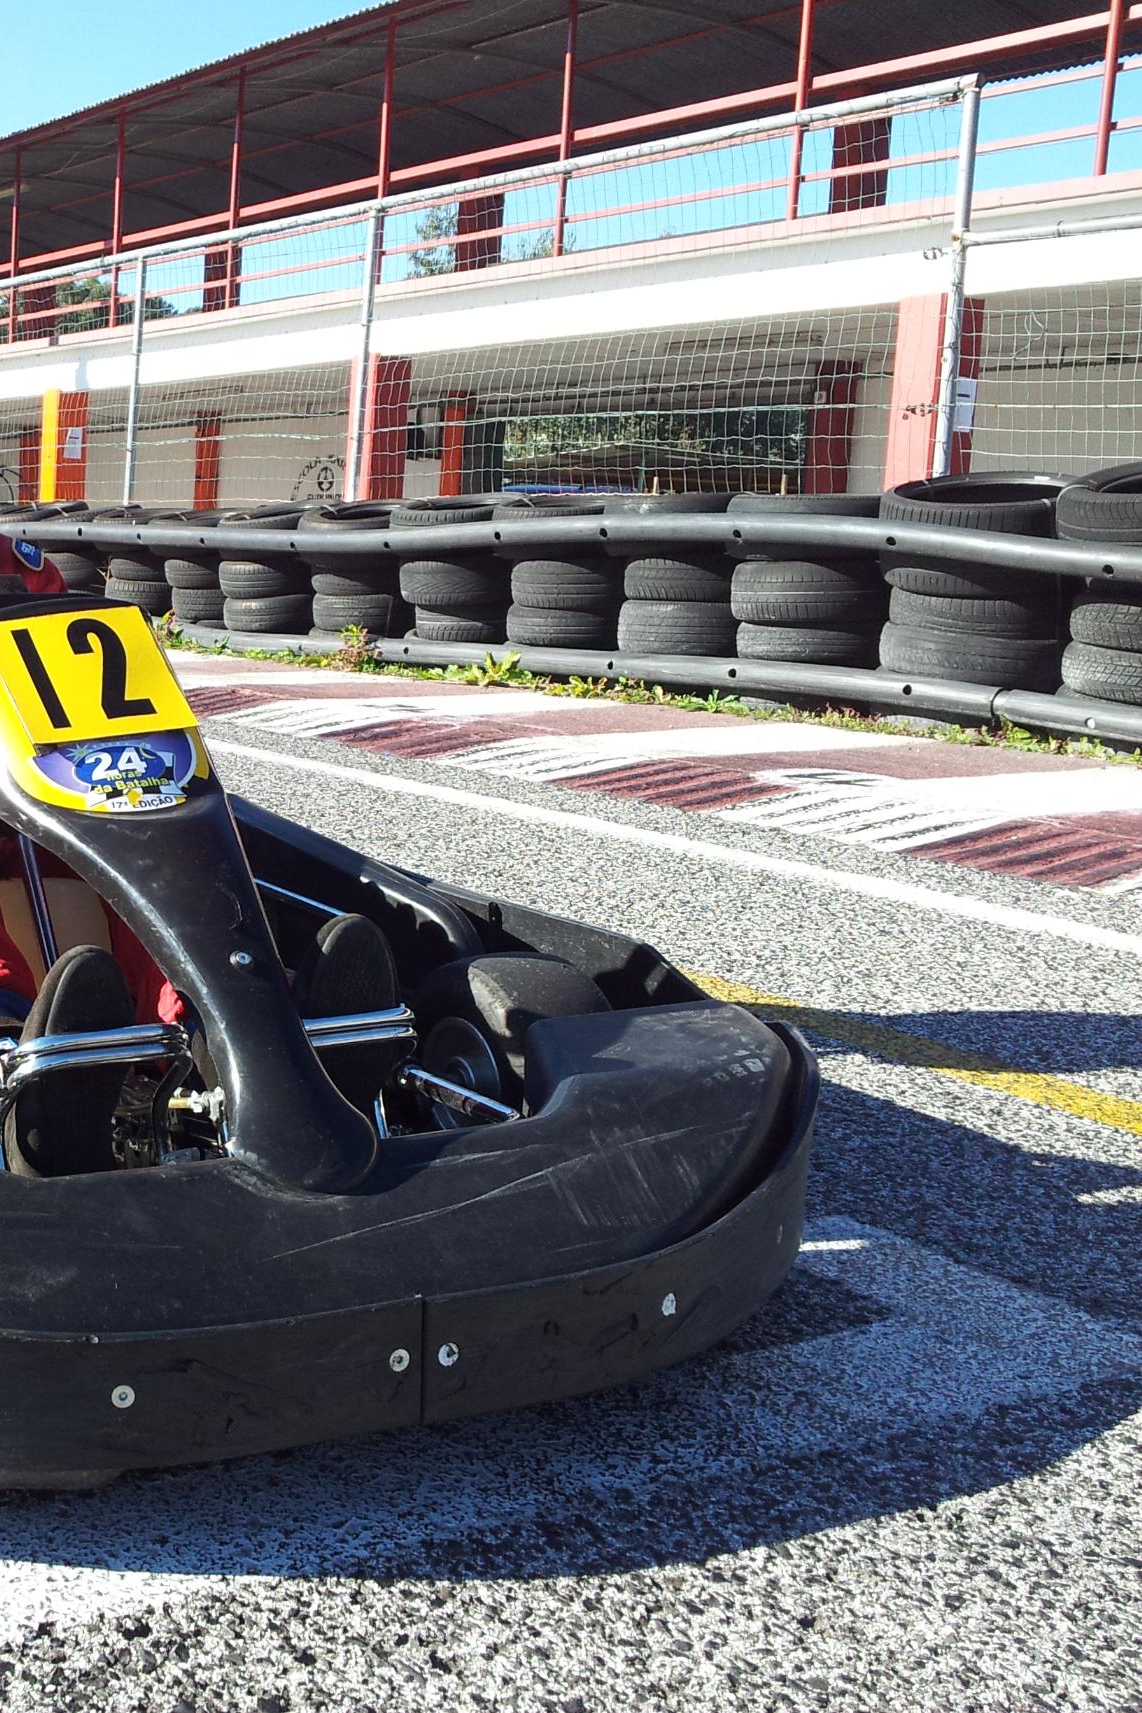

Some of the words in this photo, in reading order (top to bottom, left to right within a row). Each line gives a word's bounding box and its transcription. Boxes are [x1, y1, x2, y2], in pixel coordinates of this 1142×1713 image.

[10, 617, 158, 730] 12
[84, 747, 148, 782] 24
[94, 784, 113, 795] da
[114, 775, 170, 791] Batalha
[106, 769, 143, 781] horas
[132, 795, 174, 809] EDIÇÃO
